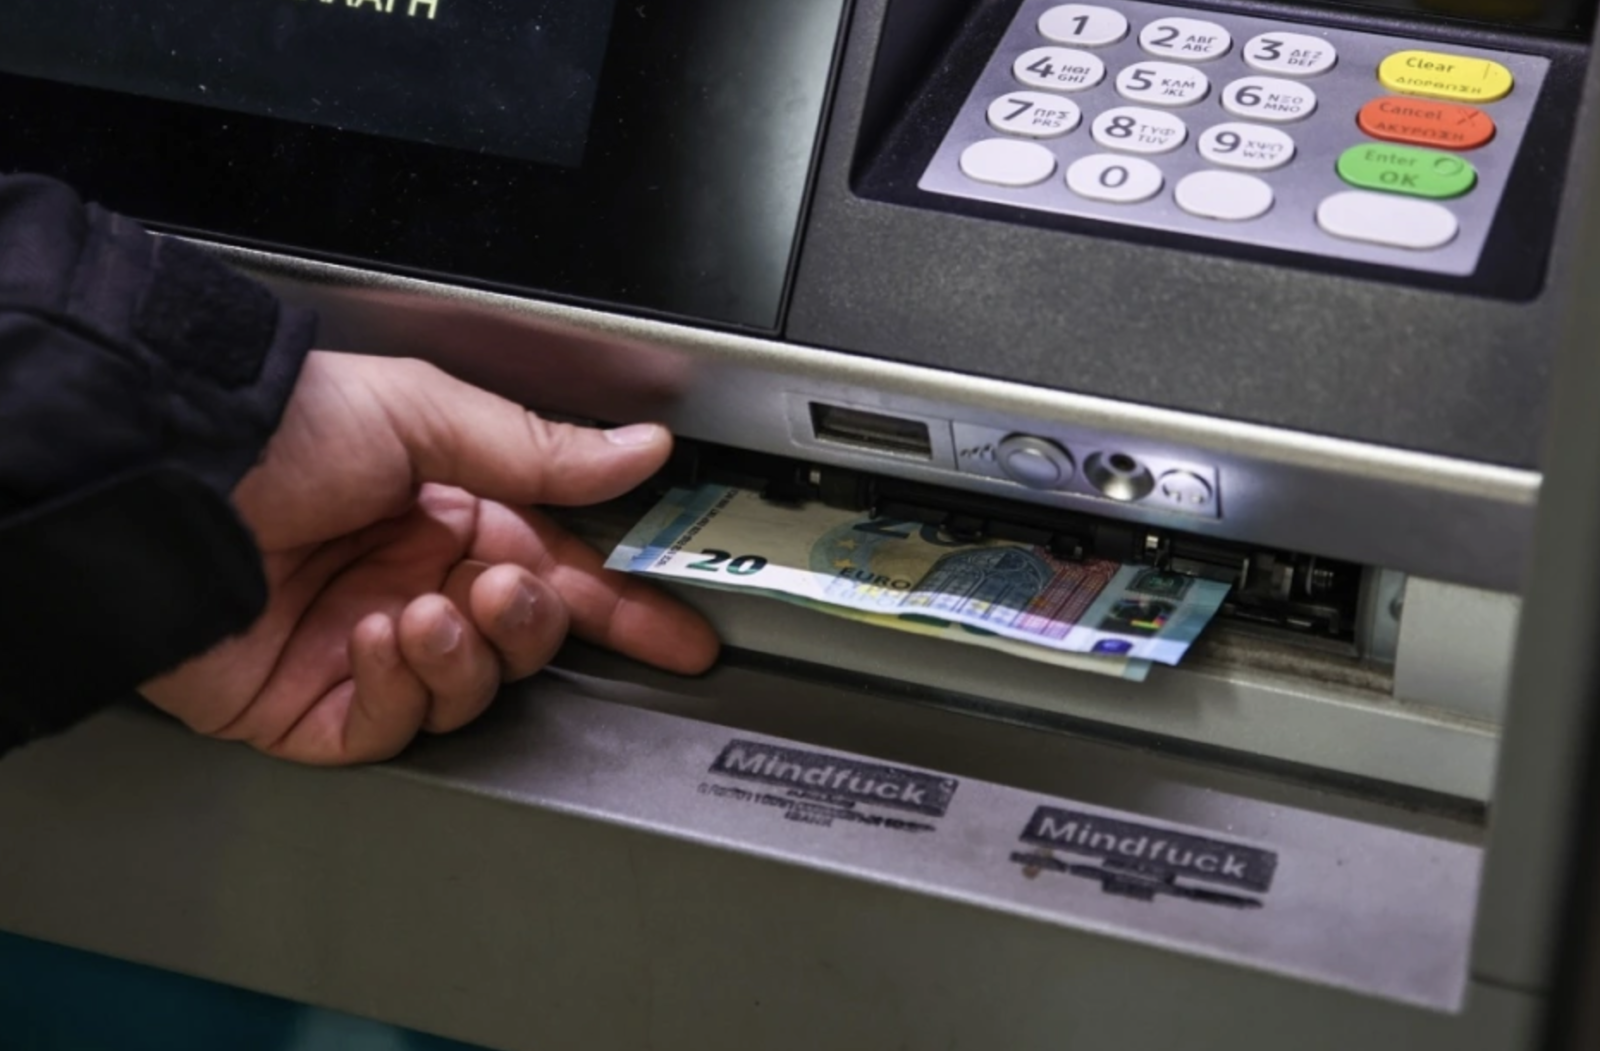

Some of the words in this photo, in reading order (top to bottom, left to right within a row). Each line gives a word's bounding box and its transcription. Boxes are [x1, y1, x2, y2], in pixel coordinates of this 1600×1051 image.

[1072, 15, 1089, 35] 1
[1150, 25, 1180, 48] 2
[1182, 43, 1213, 52] ABC
[1253, 38, 1283, 61] 3
[1025, 56, 1055, 78] 4
[1287, 57, 1318, 67] DEF
[1406, 57, 1455, 73] Clear
[1058, 74, 1086, 83] GHI
[1125, 69, 1156, 91] 5
[1161, 88, 1186, 97] JKL
[1235, 85, 1263, 106] 6
[1002, 98, 1034, 121] 7
[1263, 103, 1301, 113] MNO
[1379, 102, 1442, 121] Cancel
[1032, 118, 1062, 128] PRS
[1105, 115, 1136, 138] 8
[1138, 134, 1168, 145] TUV
[1212, 131, 1241, 153] 9
[1242, 150, 1278, 161] WXY
[1364, 149, 1418, 167] Enter
[1099, 165, 1129, 188] 0
[1379, 170, 1420, 188] OK
[685, 548, 768, 576] 20
[839, 567, 912, 590] EURO
[724, 748, 928, 804] Mindfuck
[1037, 817, 1249, 879] Mindfuck
